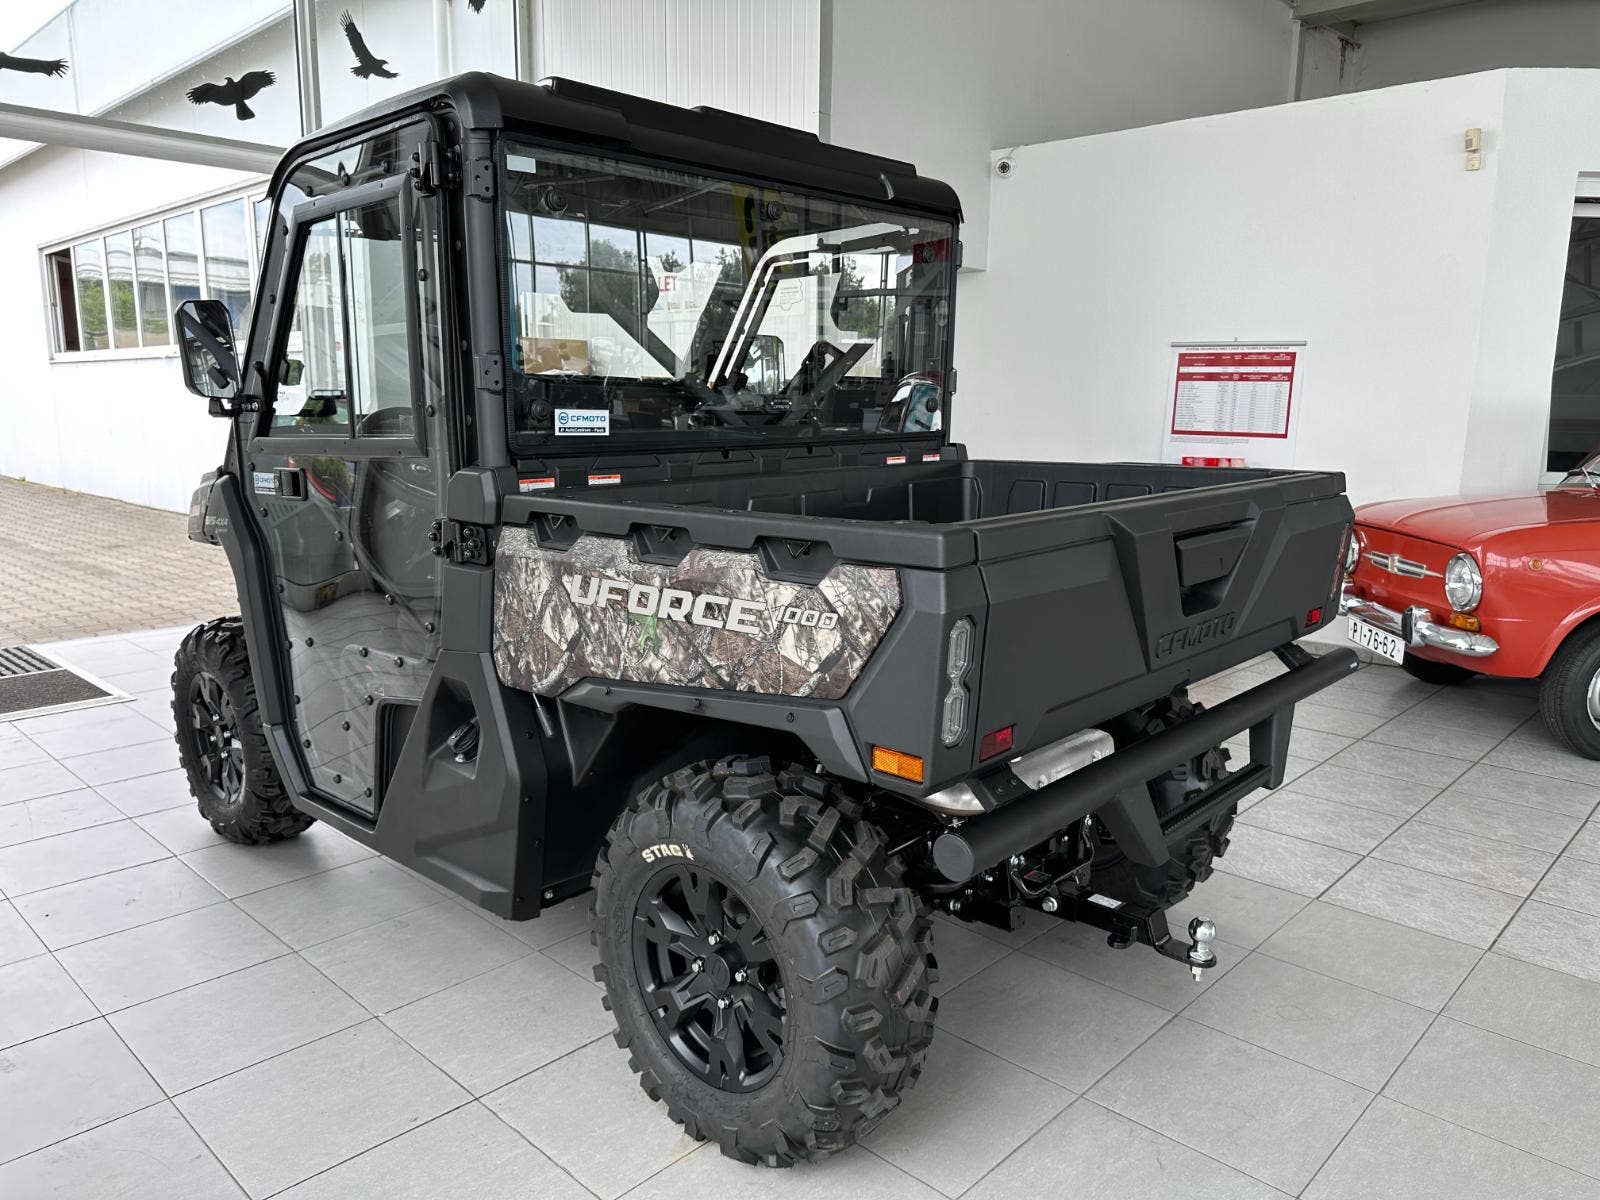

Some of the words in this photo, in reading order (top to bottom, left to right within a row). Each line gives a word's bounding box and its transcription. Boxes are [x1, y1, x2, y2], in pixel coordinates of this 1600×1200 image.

[570, 574, 767, 636] UFORCE
[776, 606, 839, 630] 1000
[1155, 611, 1236, 659] CFMOTO
[1352, 622, 1397, 658] PI-76-62
